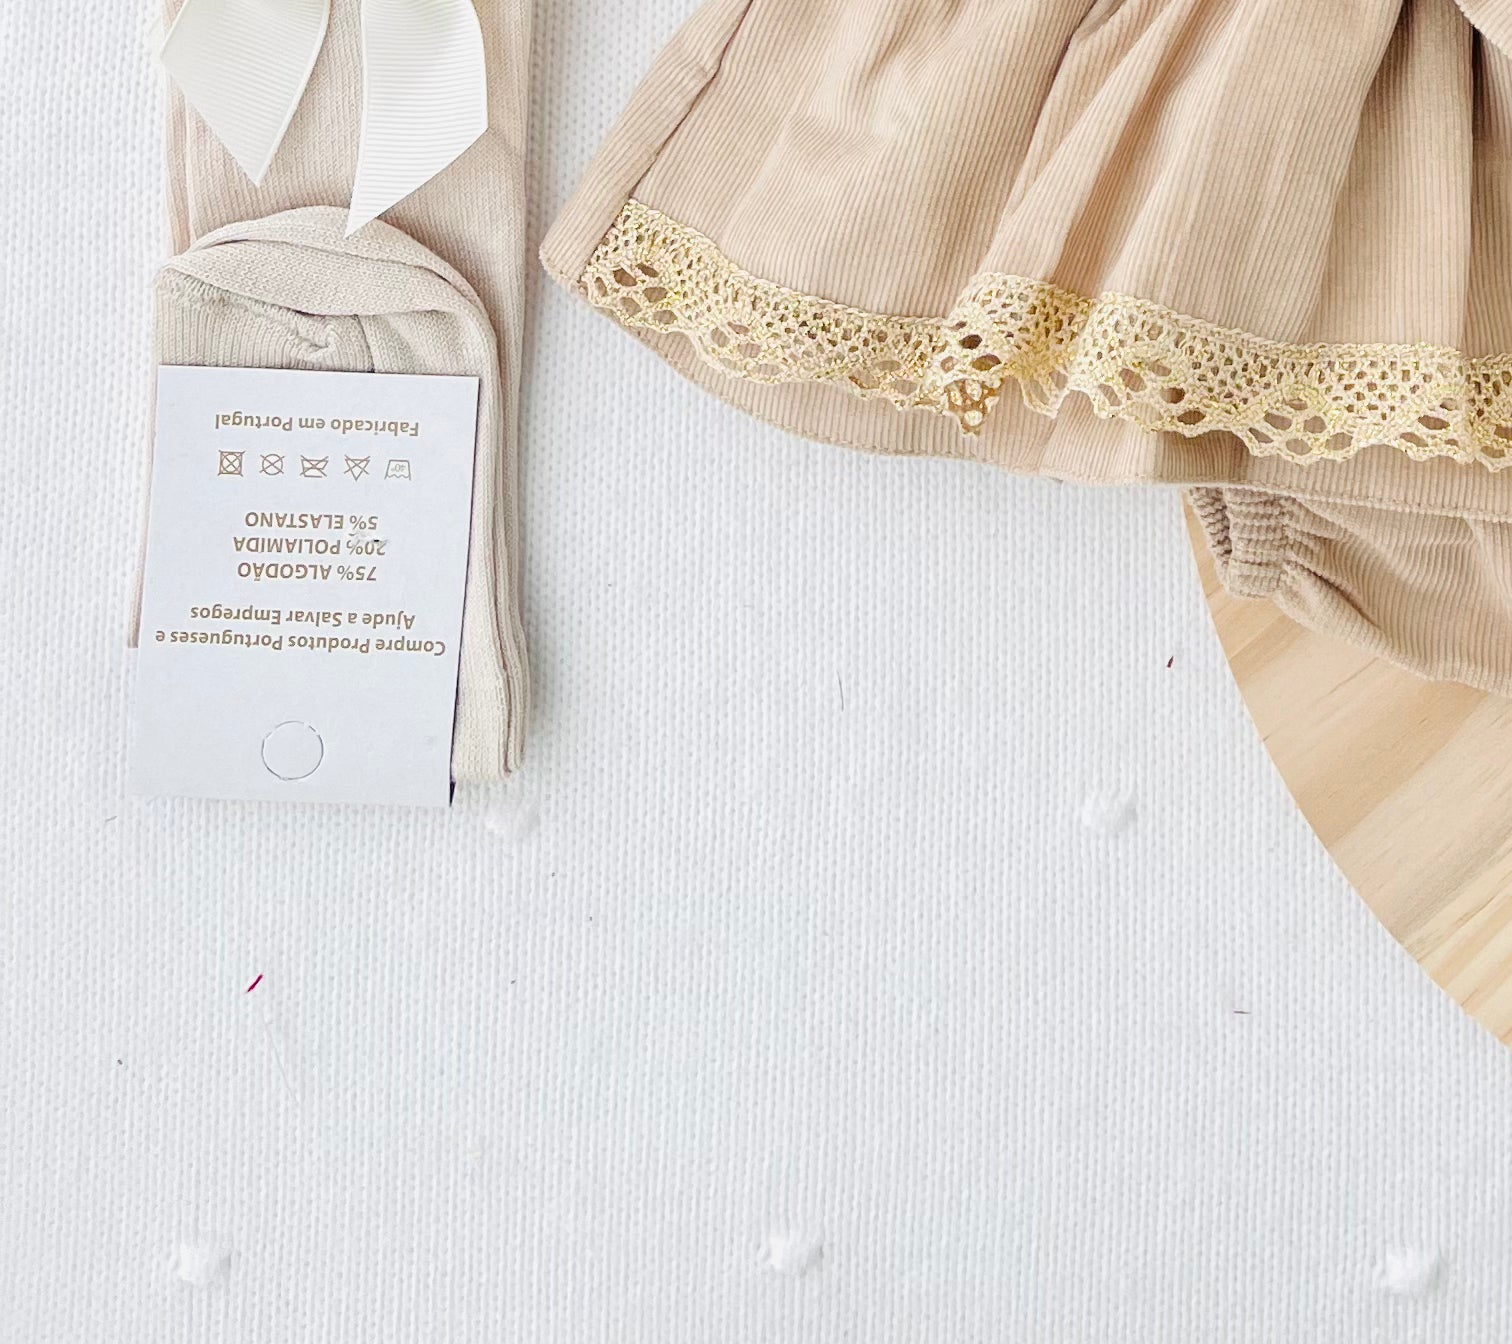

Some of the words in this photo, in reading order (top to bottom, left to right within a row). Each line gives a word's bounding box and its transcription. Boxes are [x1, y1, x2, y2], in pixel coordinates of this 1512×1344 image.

[215, 411, 292, 431] Portugal
[299, 418, 325, 429] em
[331, 419, 418, 436] Fabricado
[245, 512, 343, 529] ELASTANO
[350, 516, 378, 530] 5%
[233, 537, 340, 554] POLIAMIDA
[346, 539, 387, 556] 20%
[238, 562, 332, 581] ALGODÃO
[337, 565, 376, 581] 75%
[191, 604, 281, 625] Empregos
[286, 611, 342, 627] Salvar
[348, 613, 357, 624] a
[362, 611, 415, 629] Ajude
[156, 631, 165, 641] e
[171, 630, 283, 650] Portugueses
[288, 636, 370, 653] Produtos
[375, 636, 445, 656] Compre
